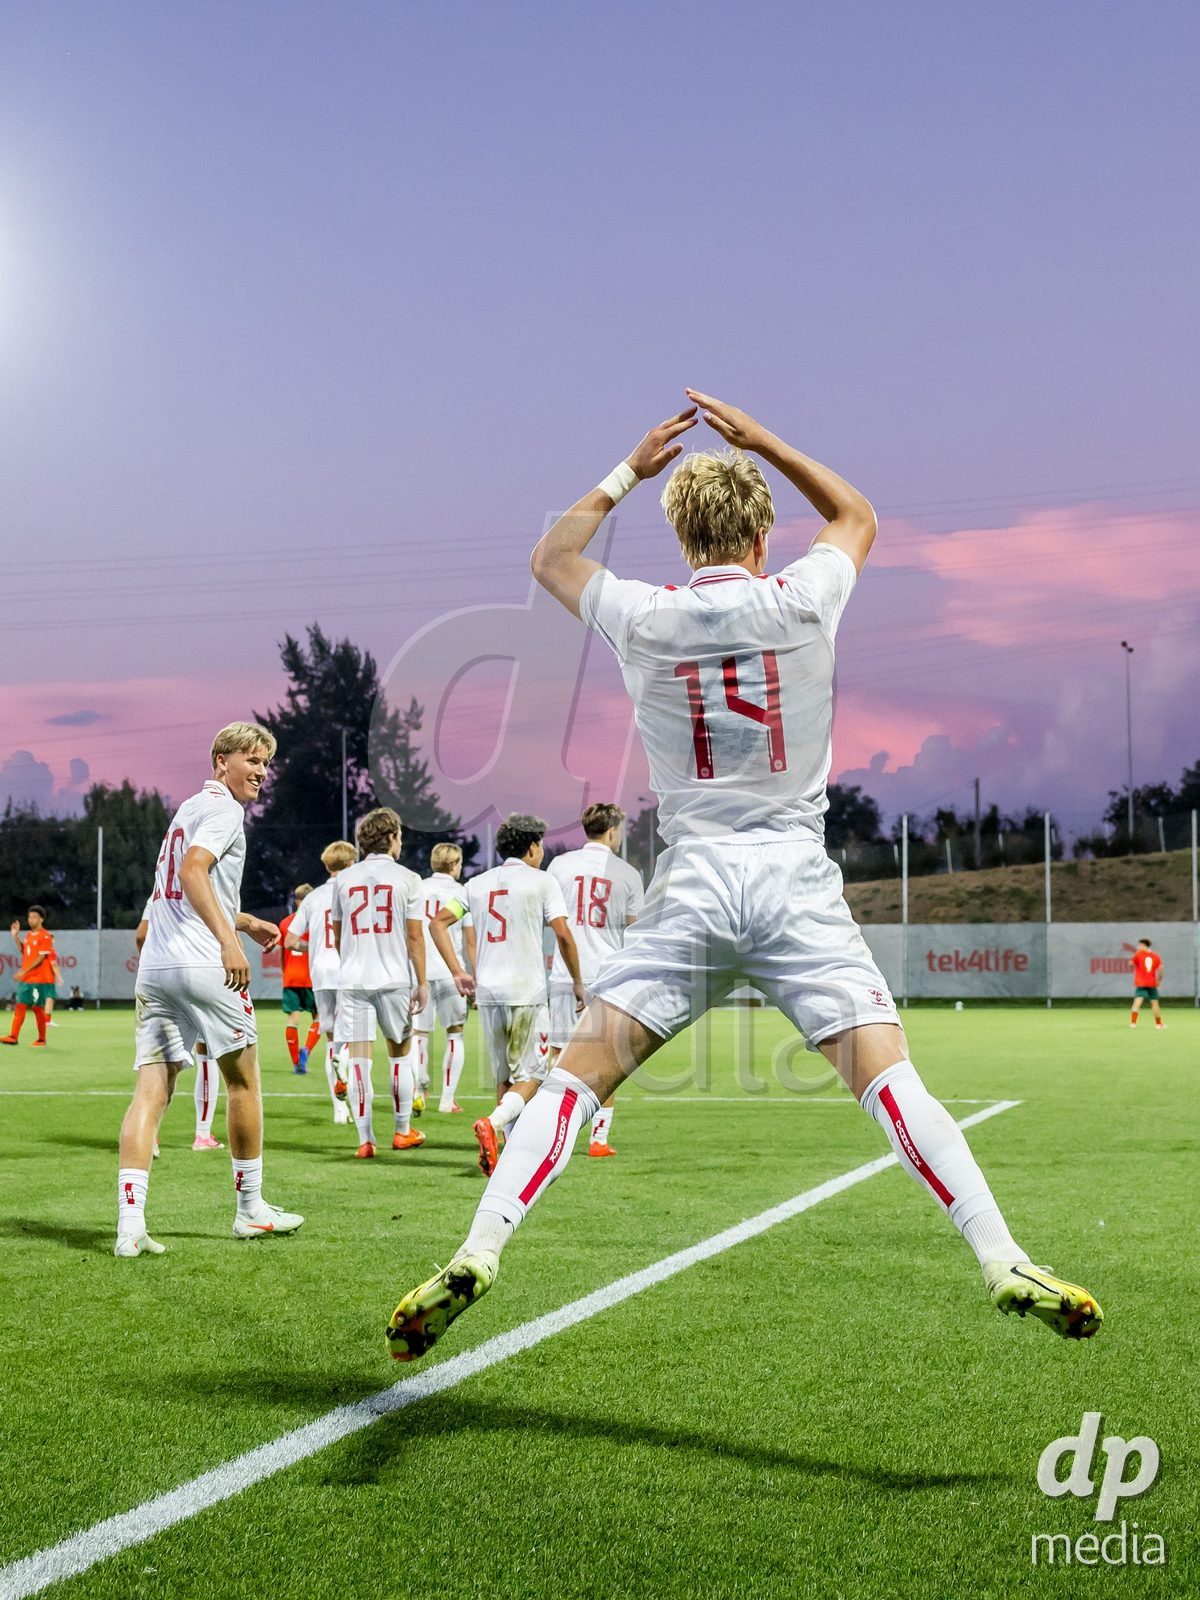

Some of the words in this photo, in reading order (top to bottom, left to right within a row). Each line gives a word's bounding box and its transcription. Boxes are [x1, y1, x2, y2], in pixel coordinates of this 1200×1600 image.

[674, 650, 787, 780] 14
[152, 827, 184, 902] 20
[349, 884, 393, 935] 23
[487, 889, 509, 943] 5
[575, 876, 612, 928] 18
[926, 949, 1029, 973] tek4life
